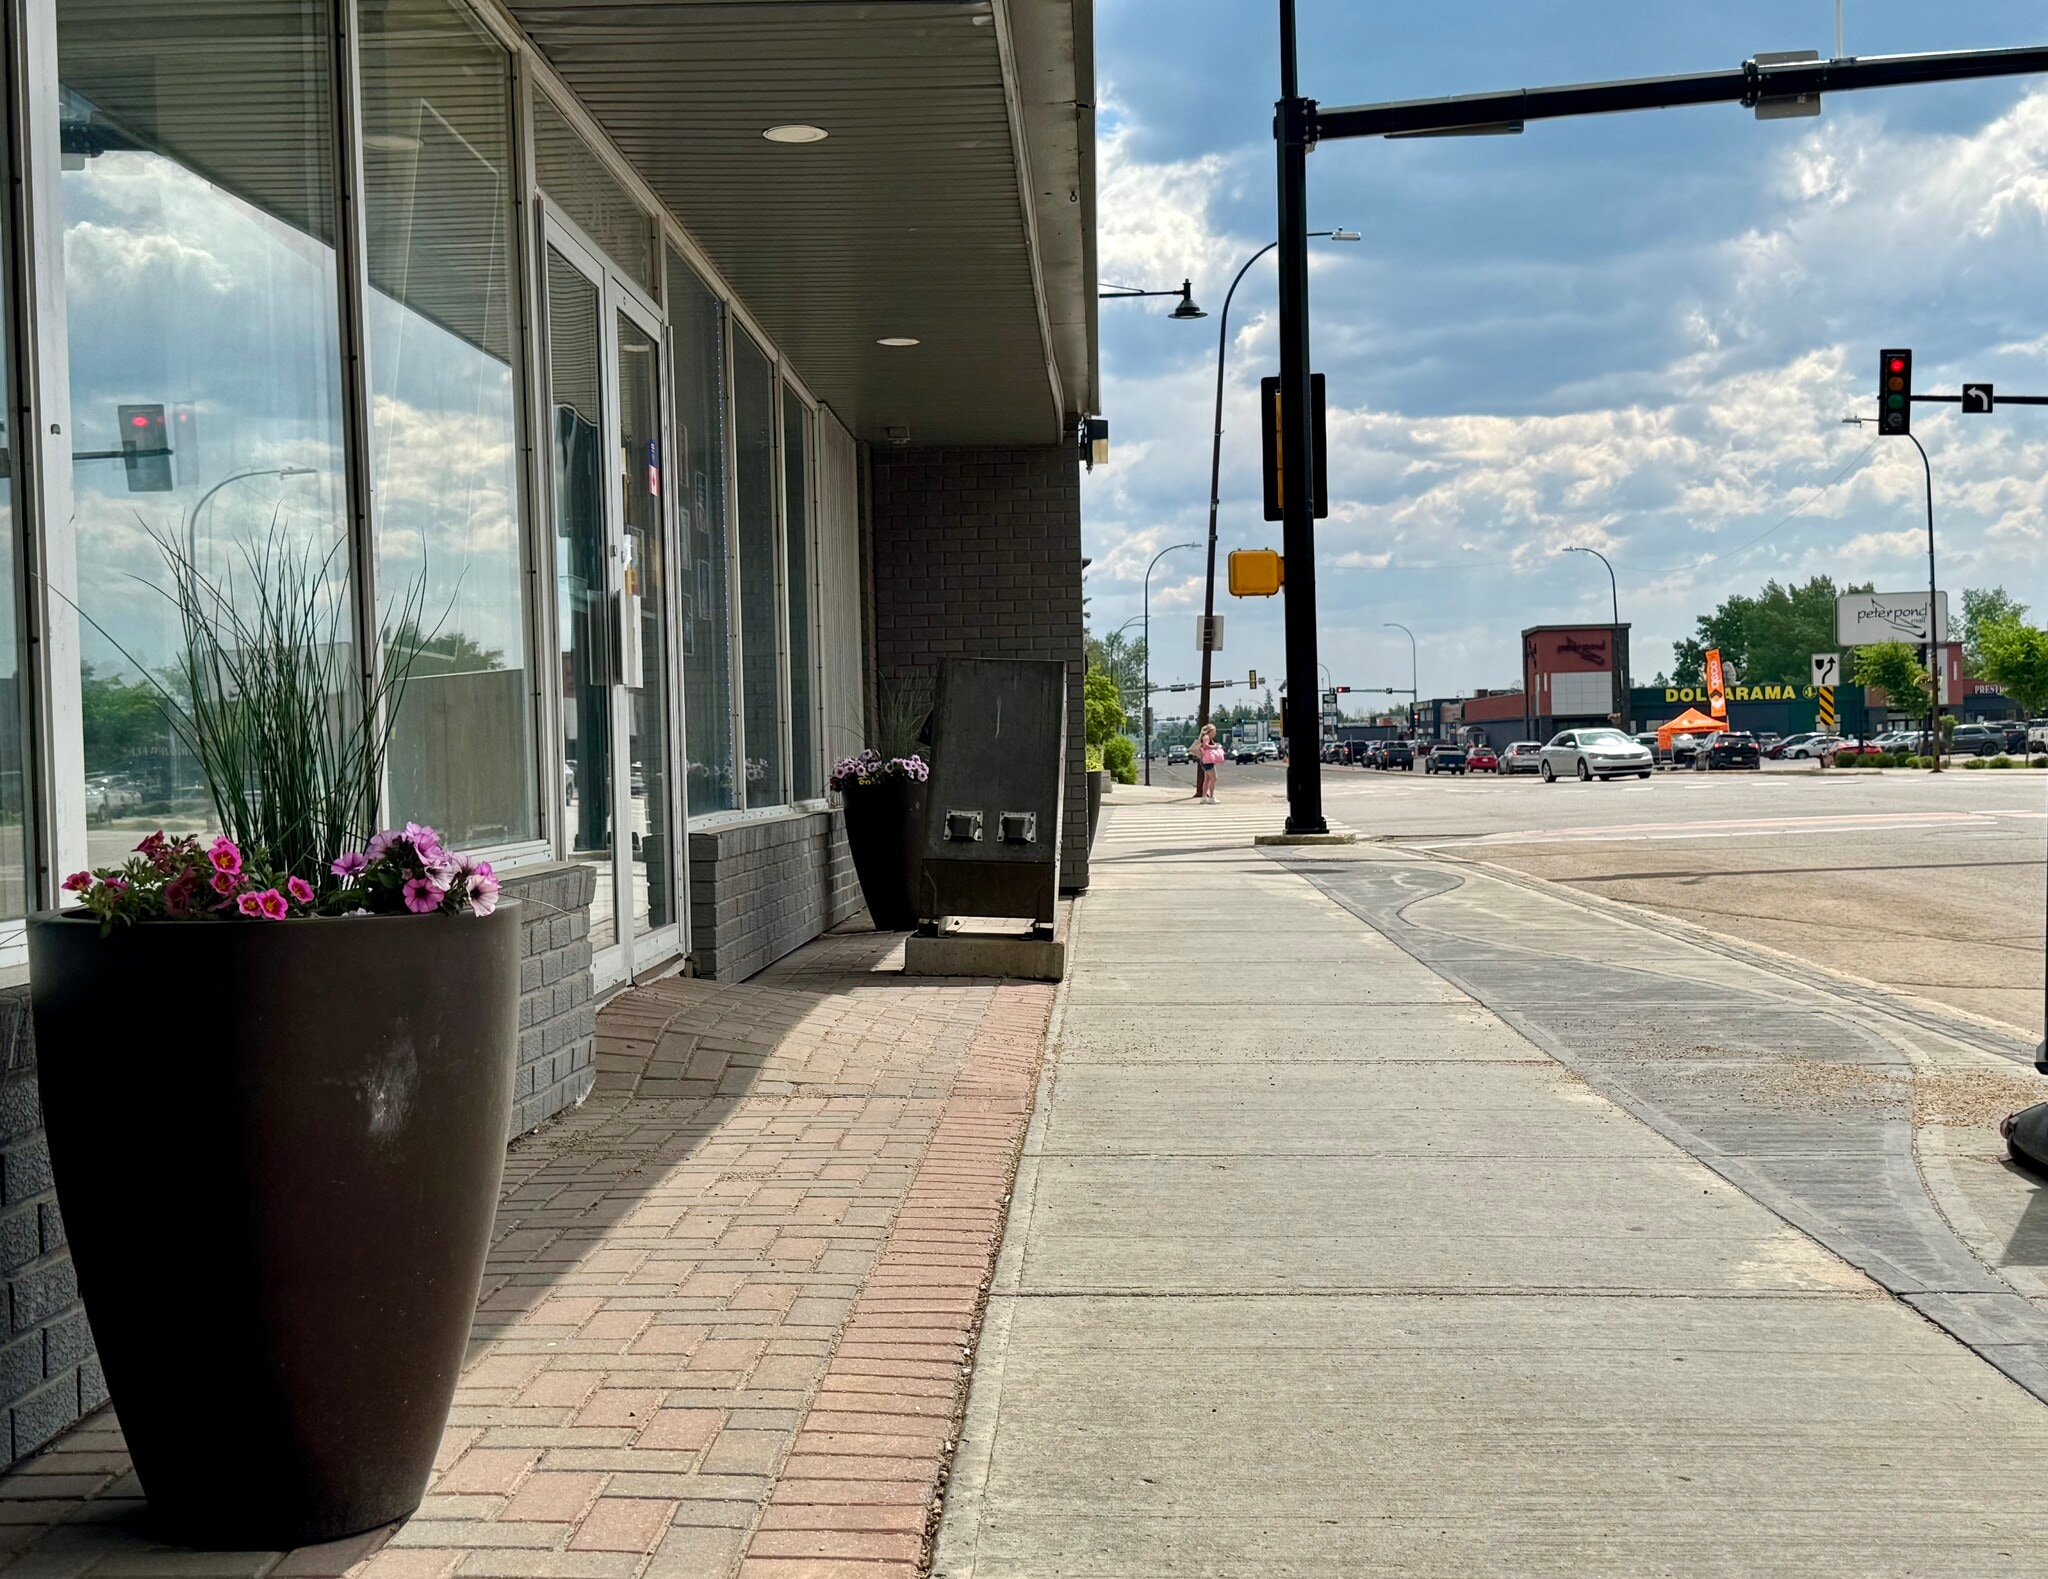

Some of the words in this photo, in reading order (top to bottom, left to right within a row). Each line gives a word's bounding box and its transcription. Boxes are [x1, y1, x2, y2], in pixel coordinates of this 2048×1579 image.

[1857, 606, 1893, 624] peter
[1893, 601, 1928, 623] pond
[1665, 685, 1797, 703] DOLARAMA
[1974, 684, 2005, 695] PRESTI
